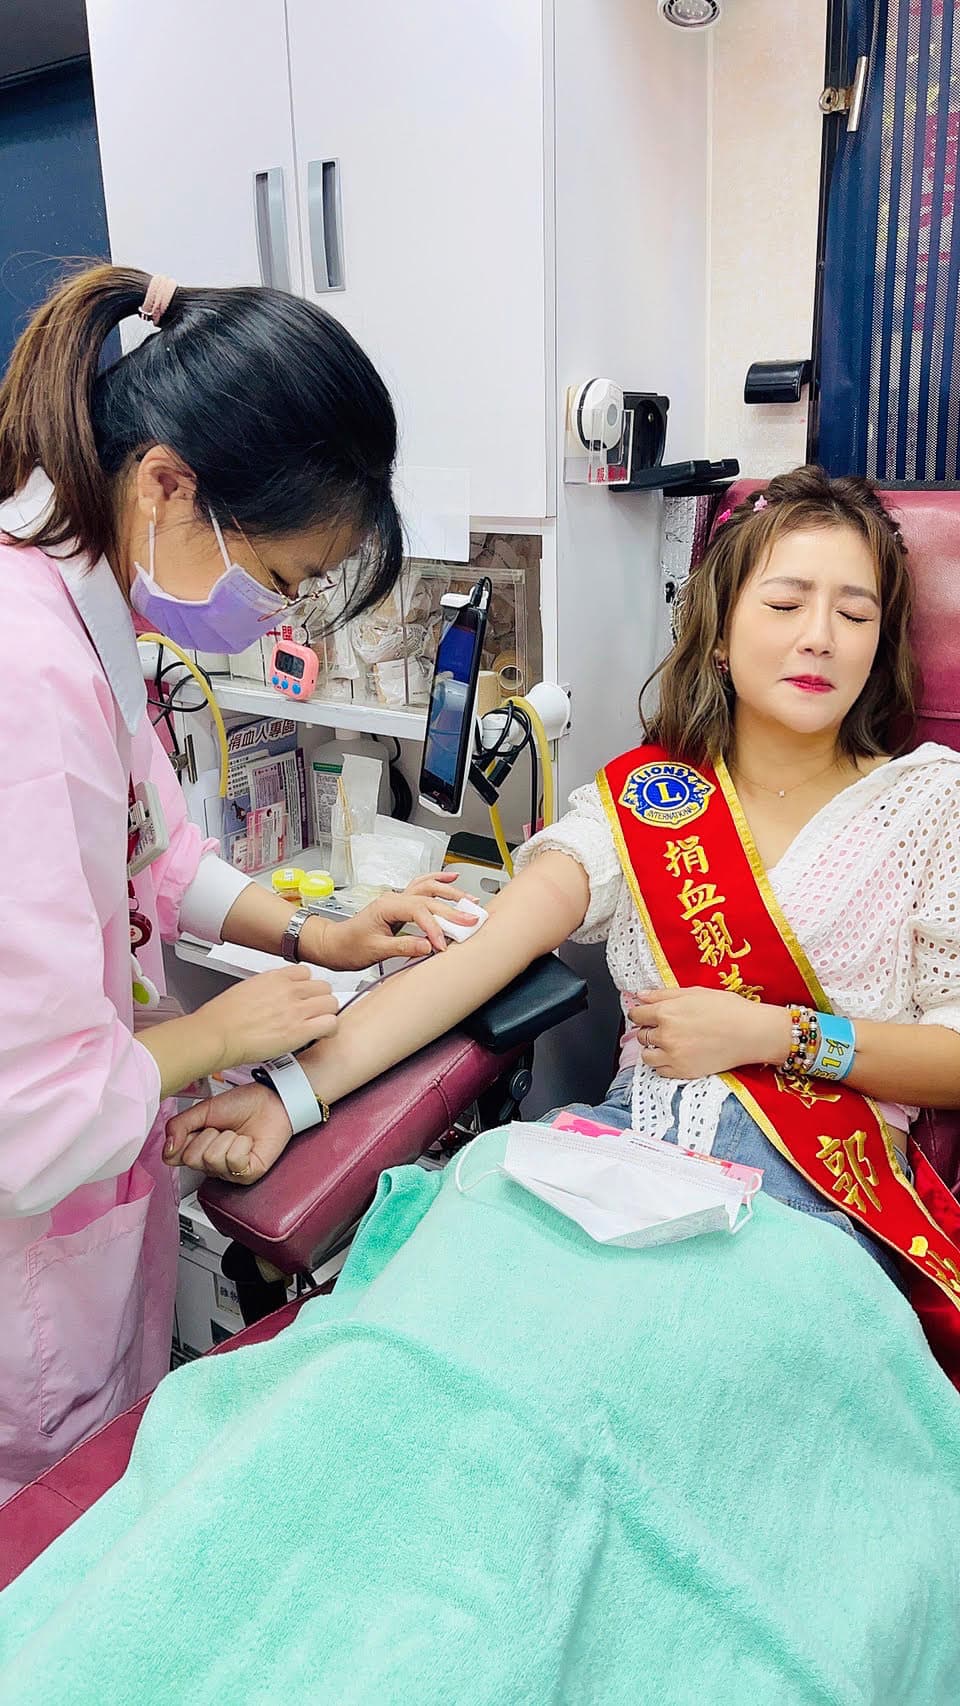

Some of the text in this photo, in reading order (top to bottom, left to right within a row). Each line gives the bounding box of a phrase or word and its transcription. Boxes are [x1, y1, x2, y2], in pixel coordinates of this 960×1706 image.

[228, 718, 296, 752] 捐血人專區
[637, 766, 686, 781] LIONS
[655, 782, 683, 804] L
[646, 803, 699, 821] INTERNATIONAL
[815, 1129, 883, 1214] 郭
